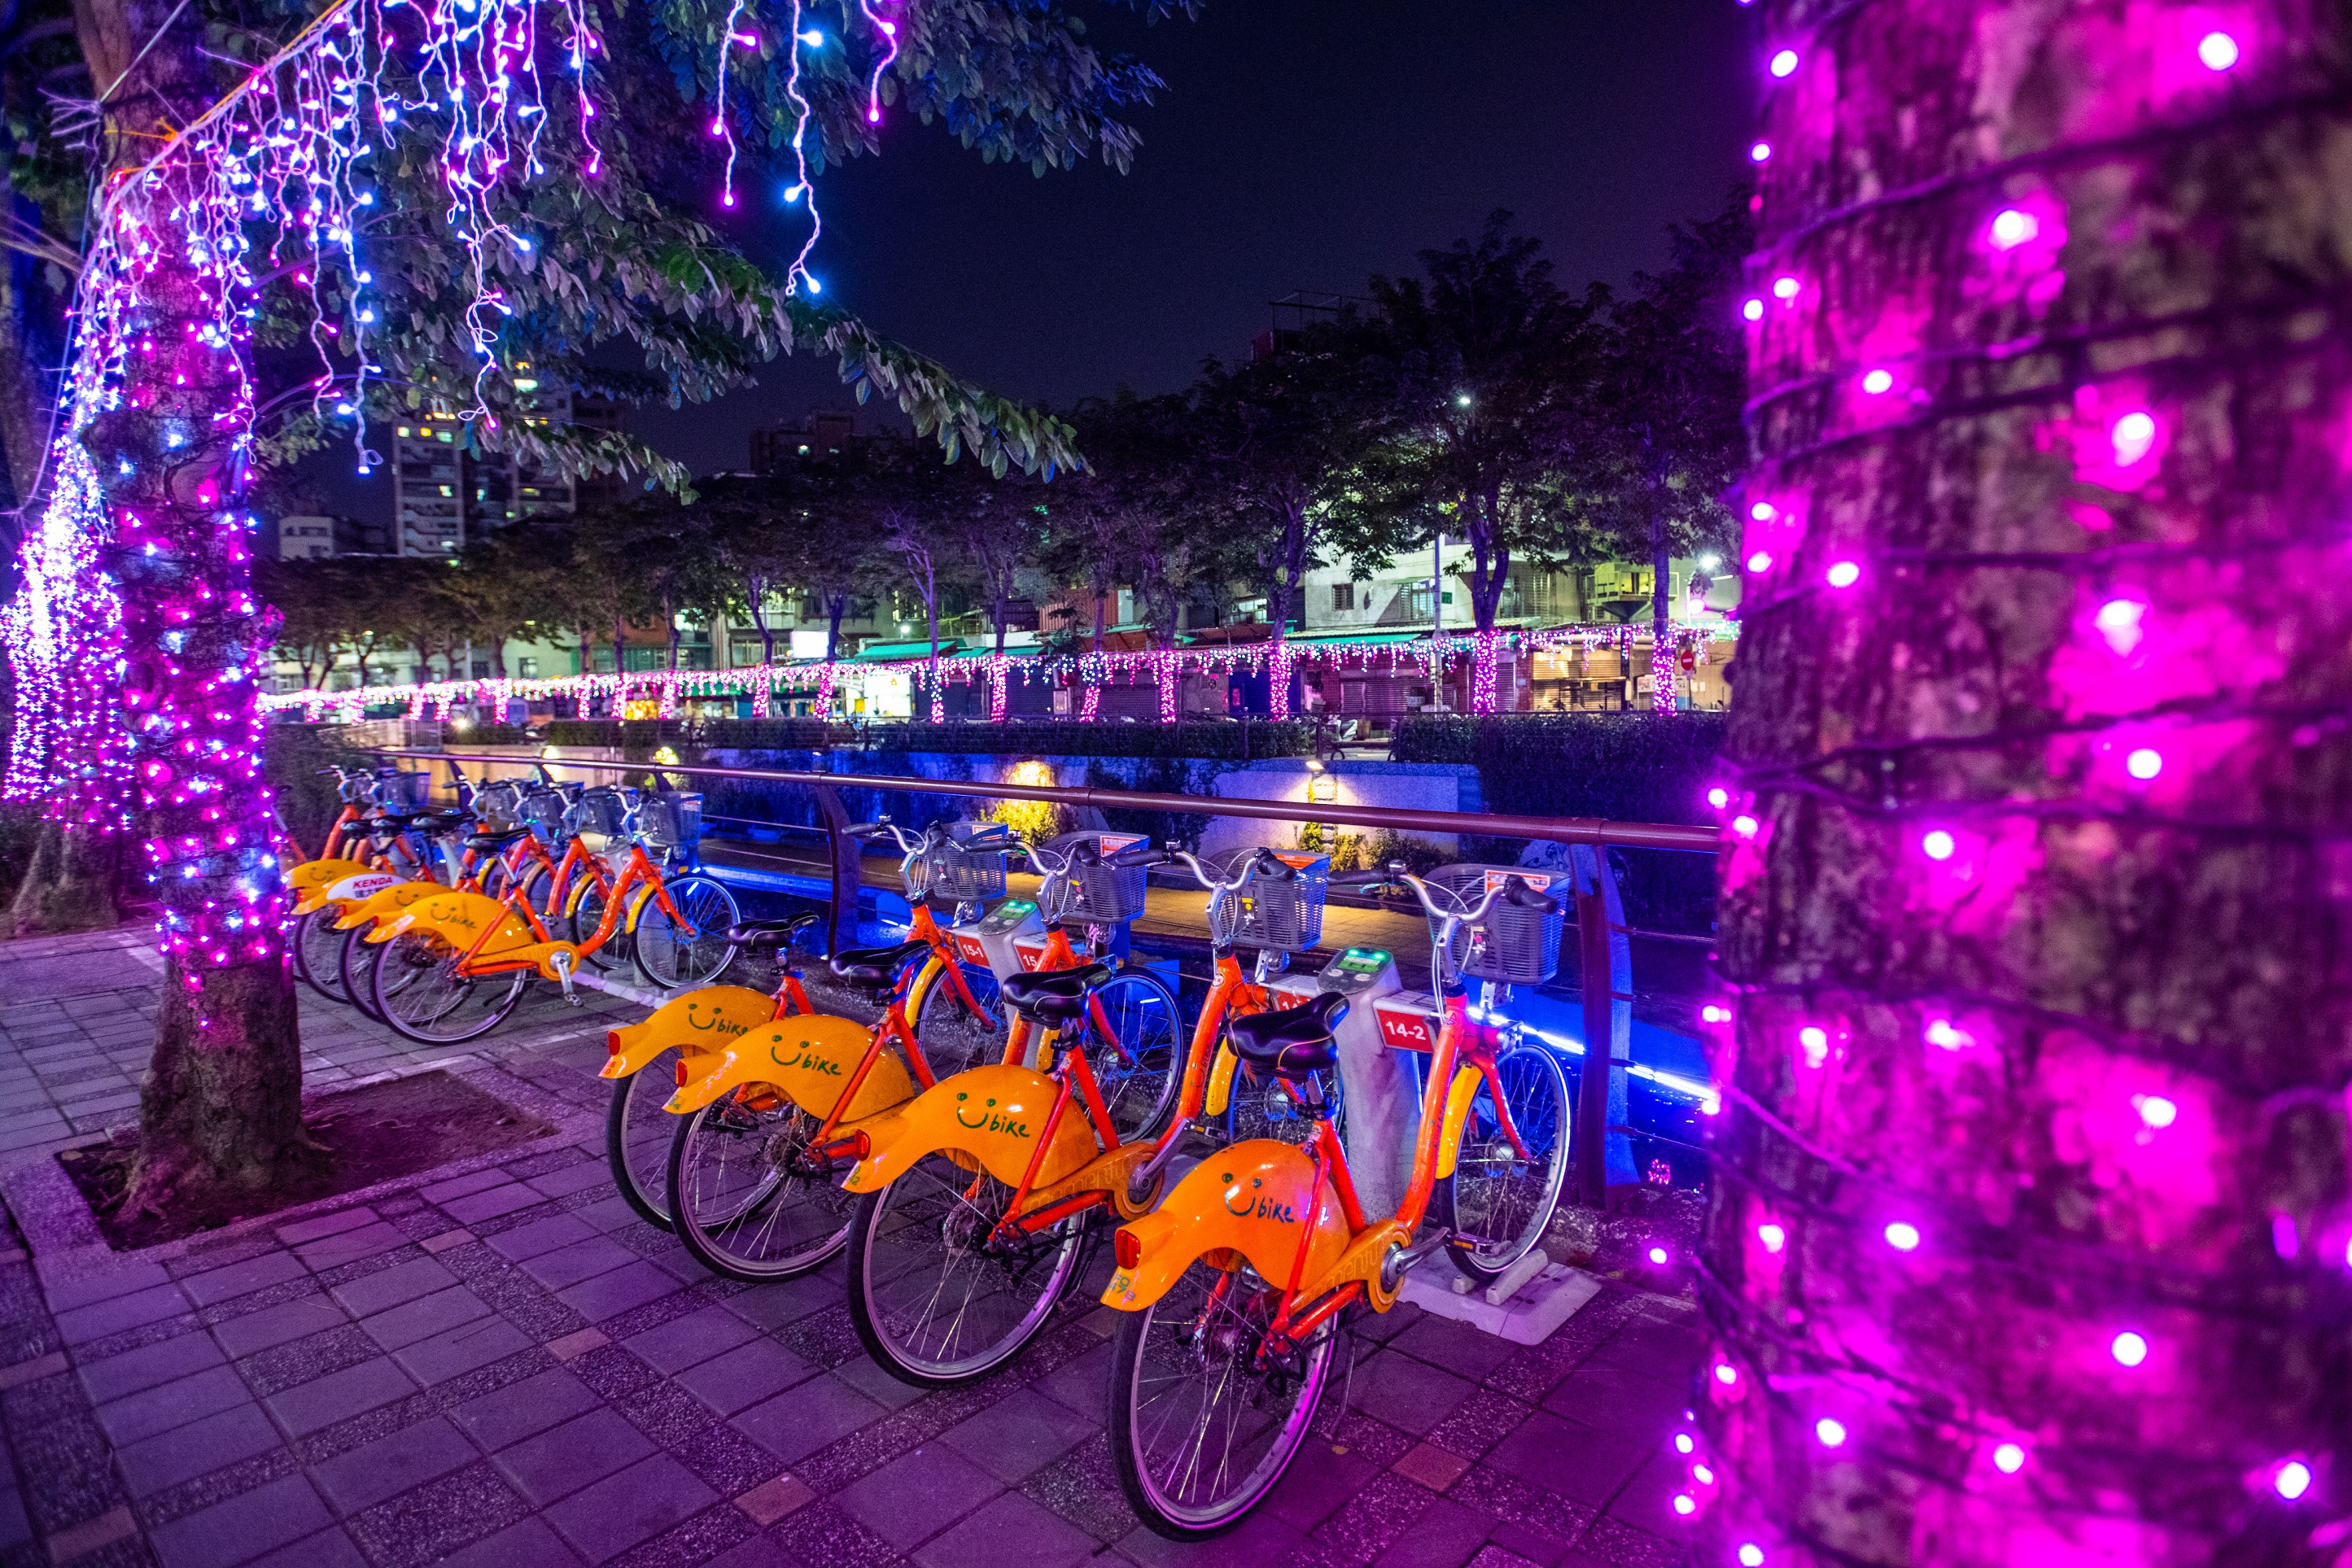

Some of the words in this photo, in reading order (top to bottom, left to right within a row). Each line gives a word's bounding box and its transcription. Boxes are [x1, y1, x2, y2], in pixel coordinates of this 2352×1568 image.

[352, 876, 392, 889] KENDA
[963, 944, 984, 958] 15-1
[1386, 1021, 1426, 1041] 14-2
